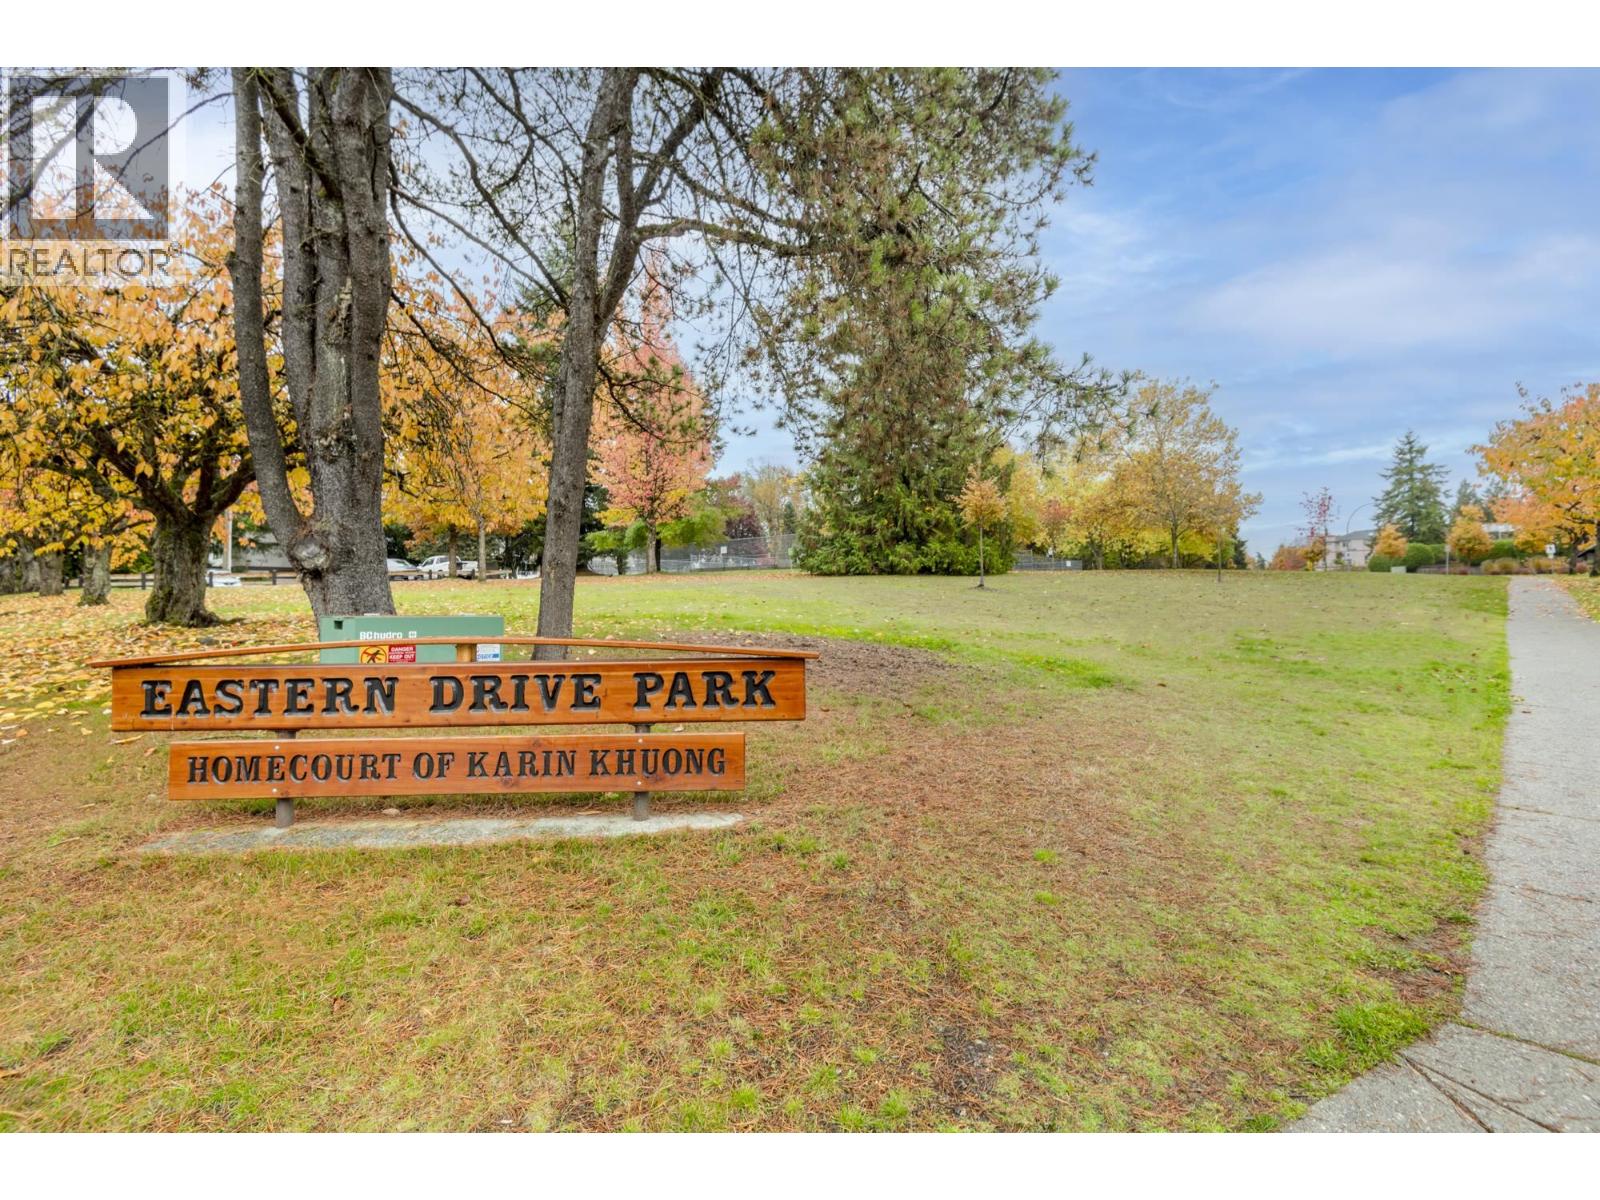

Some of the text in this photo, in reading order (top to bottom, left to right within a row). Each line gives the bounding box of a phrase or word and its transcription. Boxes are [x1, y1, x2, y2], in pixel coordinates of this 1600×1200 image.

[140, 670, 777, 719] EASTERN DRIVE PARK
[187, 747, 726, 785] HOMECOURT OF KARIN KHUONG
